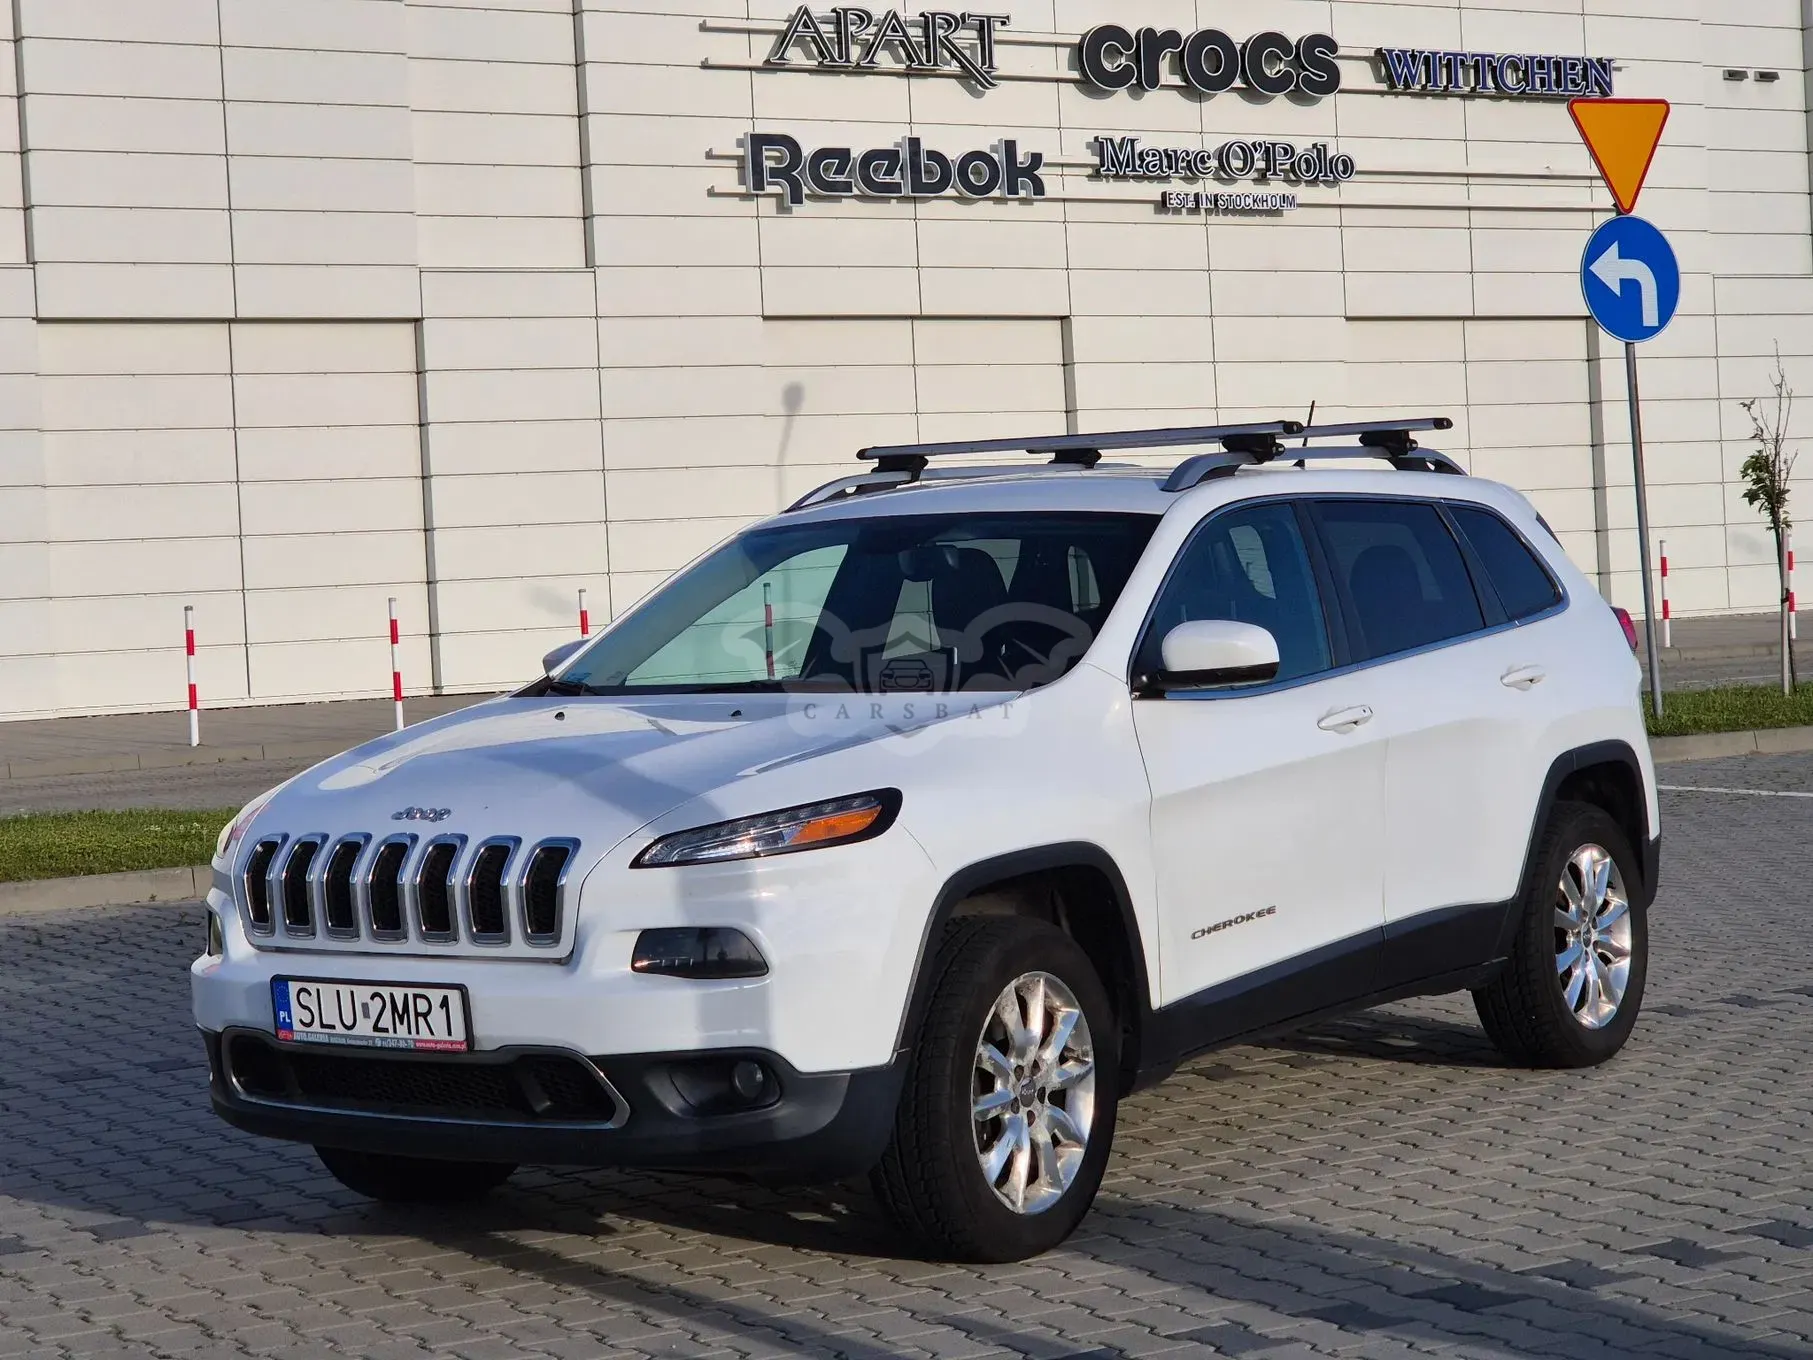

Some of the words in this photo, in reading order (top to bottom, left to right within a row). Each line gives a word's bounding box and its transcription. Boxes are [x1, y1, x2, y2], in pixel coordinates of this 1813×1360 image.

[766, 4, 1011, 90] APART
[1079, 24, 1341, 97] crocs
[1378, 48, 1616, 97] WITTCHEN
[744, 131, 1046, 207] Reebok
[1097, 136, 1215, 176] Marc
[1218, 138, 1357, 181] O'Polo
[1166, 190, 1195, 207] EST.
[1200, 191, 1214, 209] IN
[1218, 192, 1297, 210] STOCKHOLM
[1190, 905, 1277, 940] CHEROKEE
[279, 1010, 292, 1023] PL
[296, 987, 357, 1031] SLU
[369, 991, 452, 1037] 2MR1
